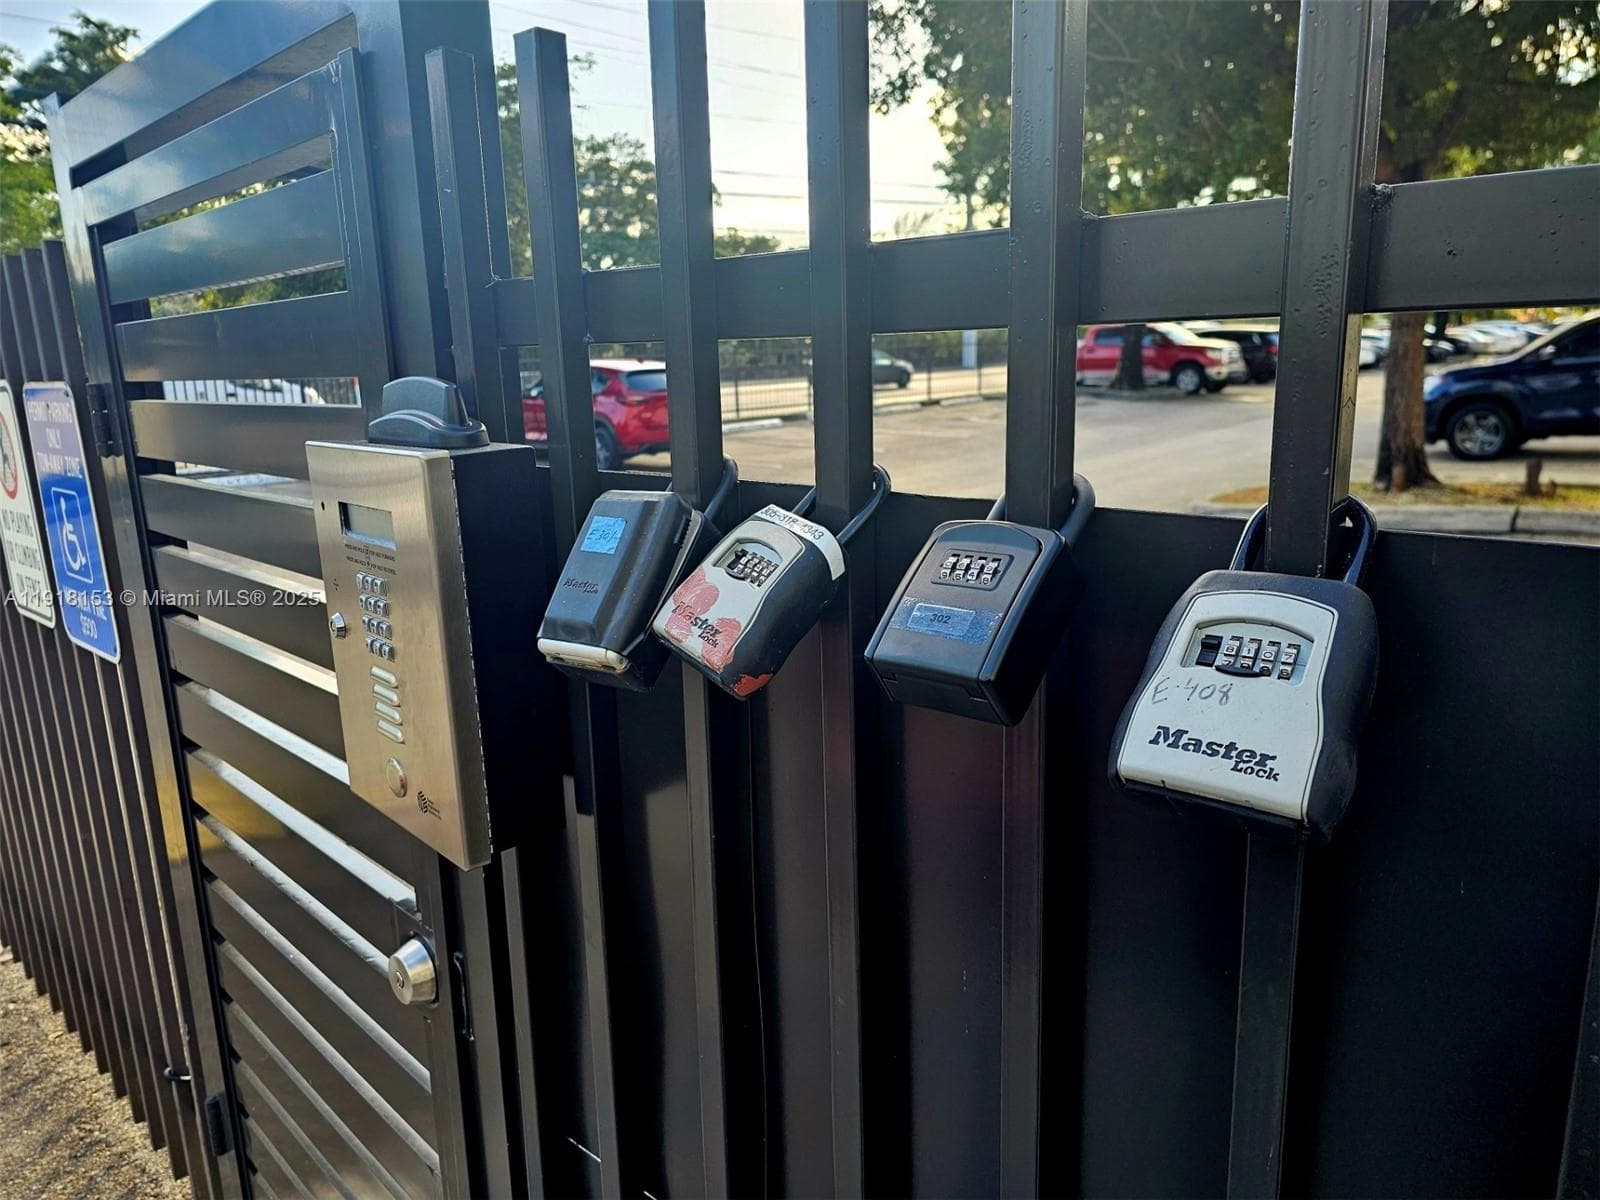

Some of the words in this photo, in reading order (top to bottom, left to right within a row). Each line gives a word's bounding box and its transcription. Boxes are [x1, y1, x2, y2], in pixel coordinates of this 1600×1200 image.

[671, 600, 722, 639] Master
[929, 613, 951, 625] 302
[698, 629, 720, 649] Lock
[1148, 724, 1278, 769] Master
[1230, 759, 1281, 782] Lock
